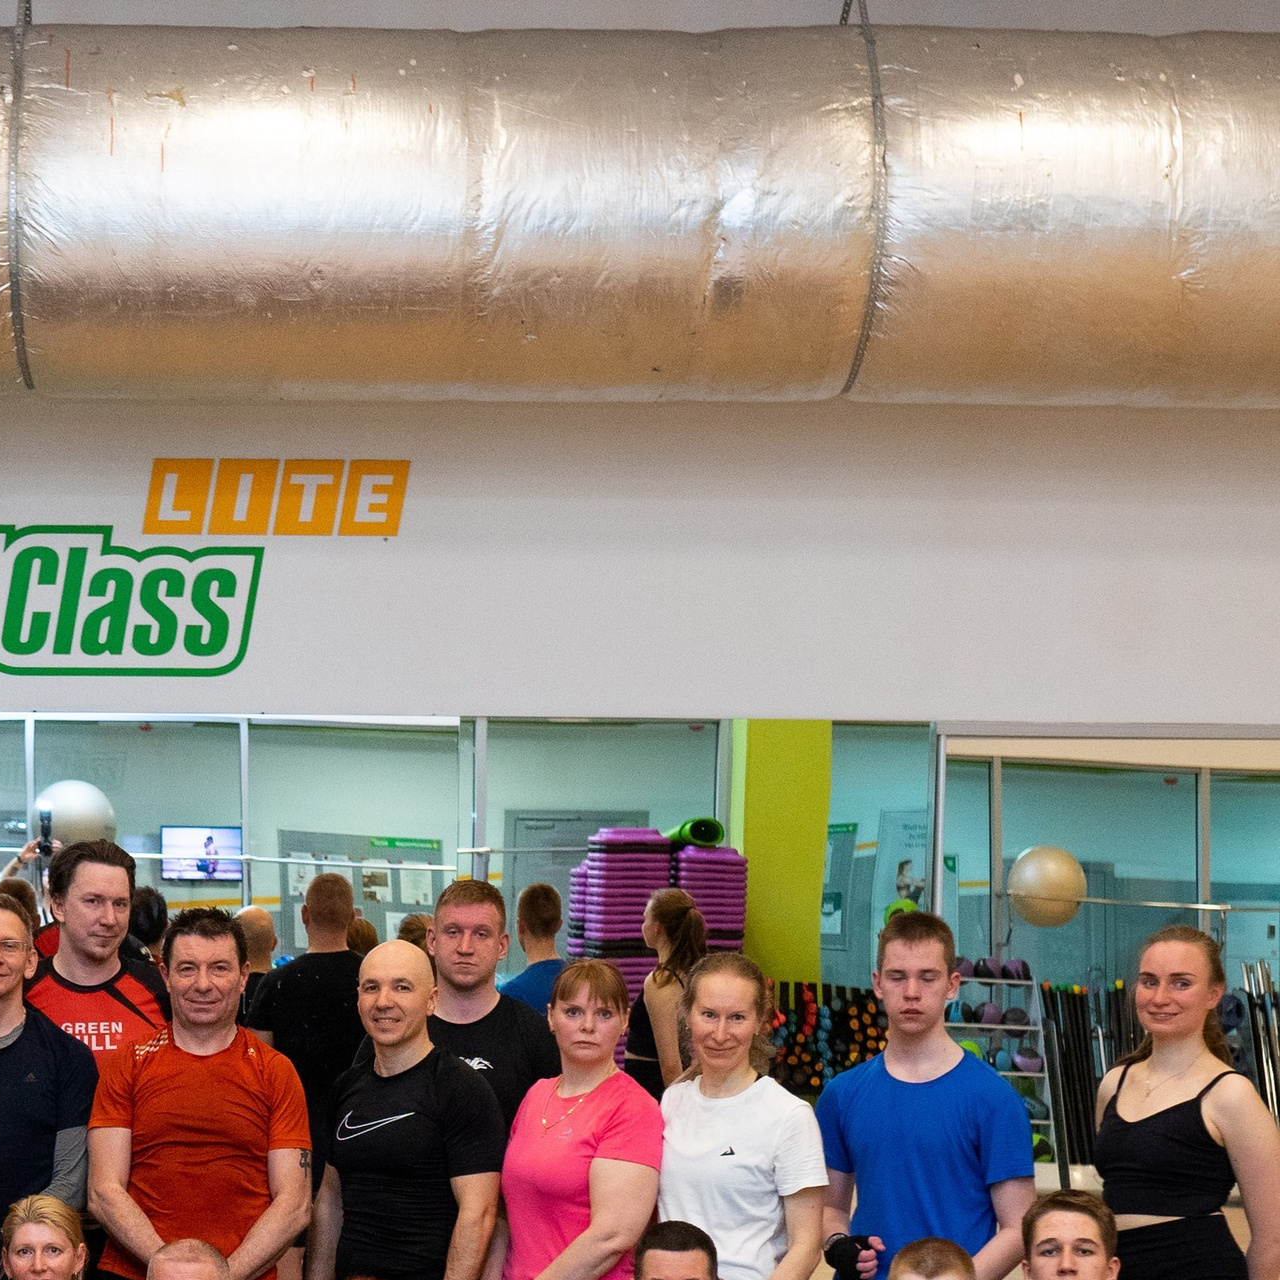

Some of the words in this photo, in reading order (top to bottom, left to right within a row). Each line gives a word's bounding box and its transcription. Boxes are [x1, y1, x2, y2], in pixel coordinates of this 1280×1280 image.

[157, 472, 394, 523] LITE
[1, 546, 238, 657] Class
[61, 1022, 123, 1034] GREEN
[76, 1034, 117, 1051] ILL
